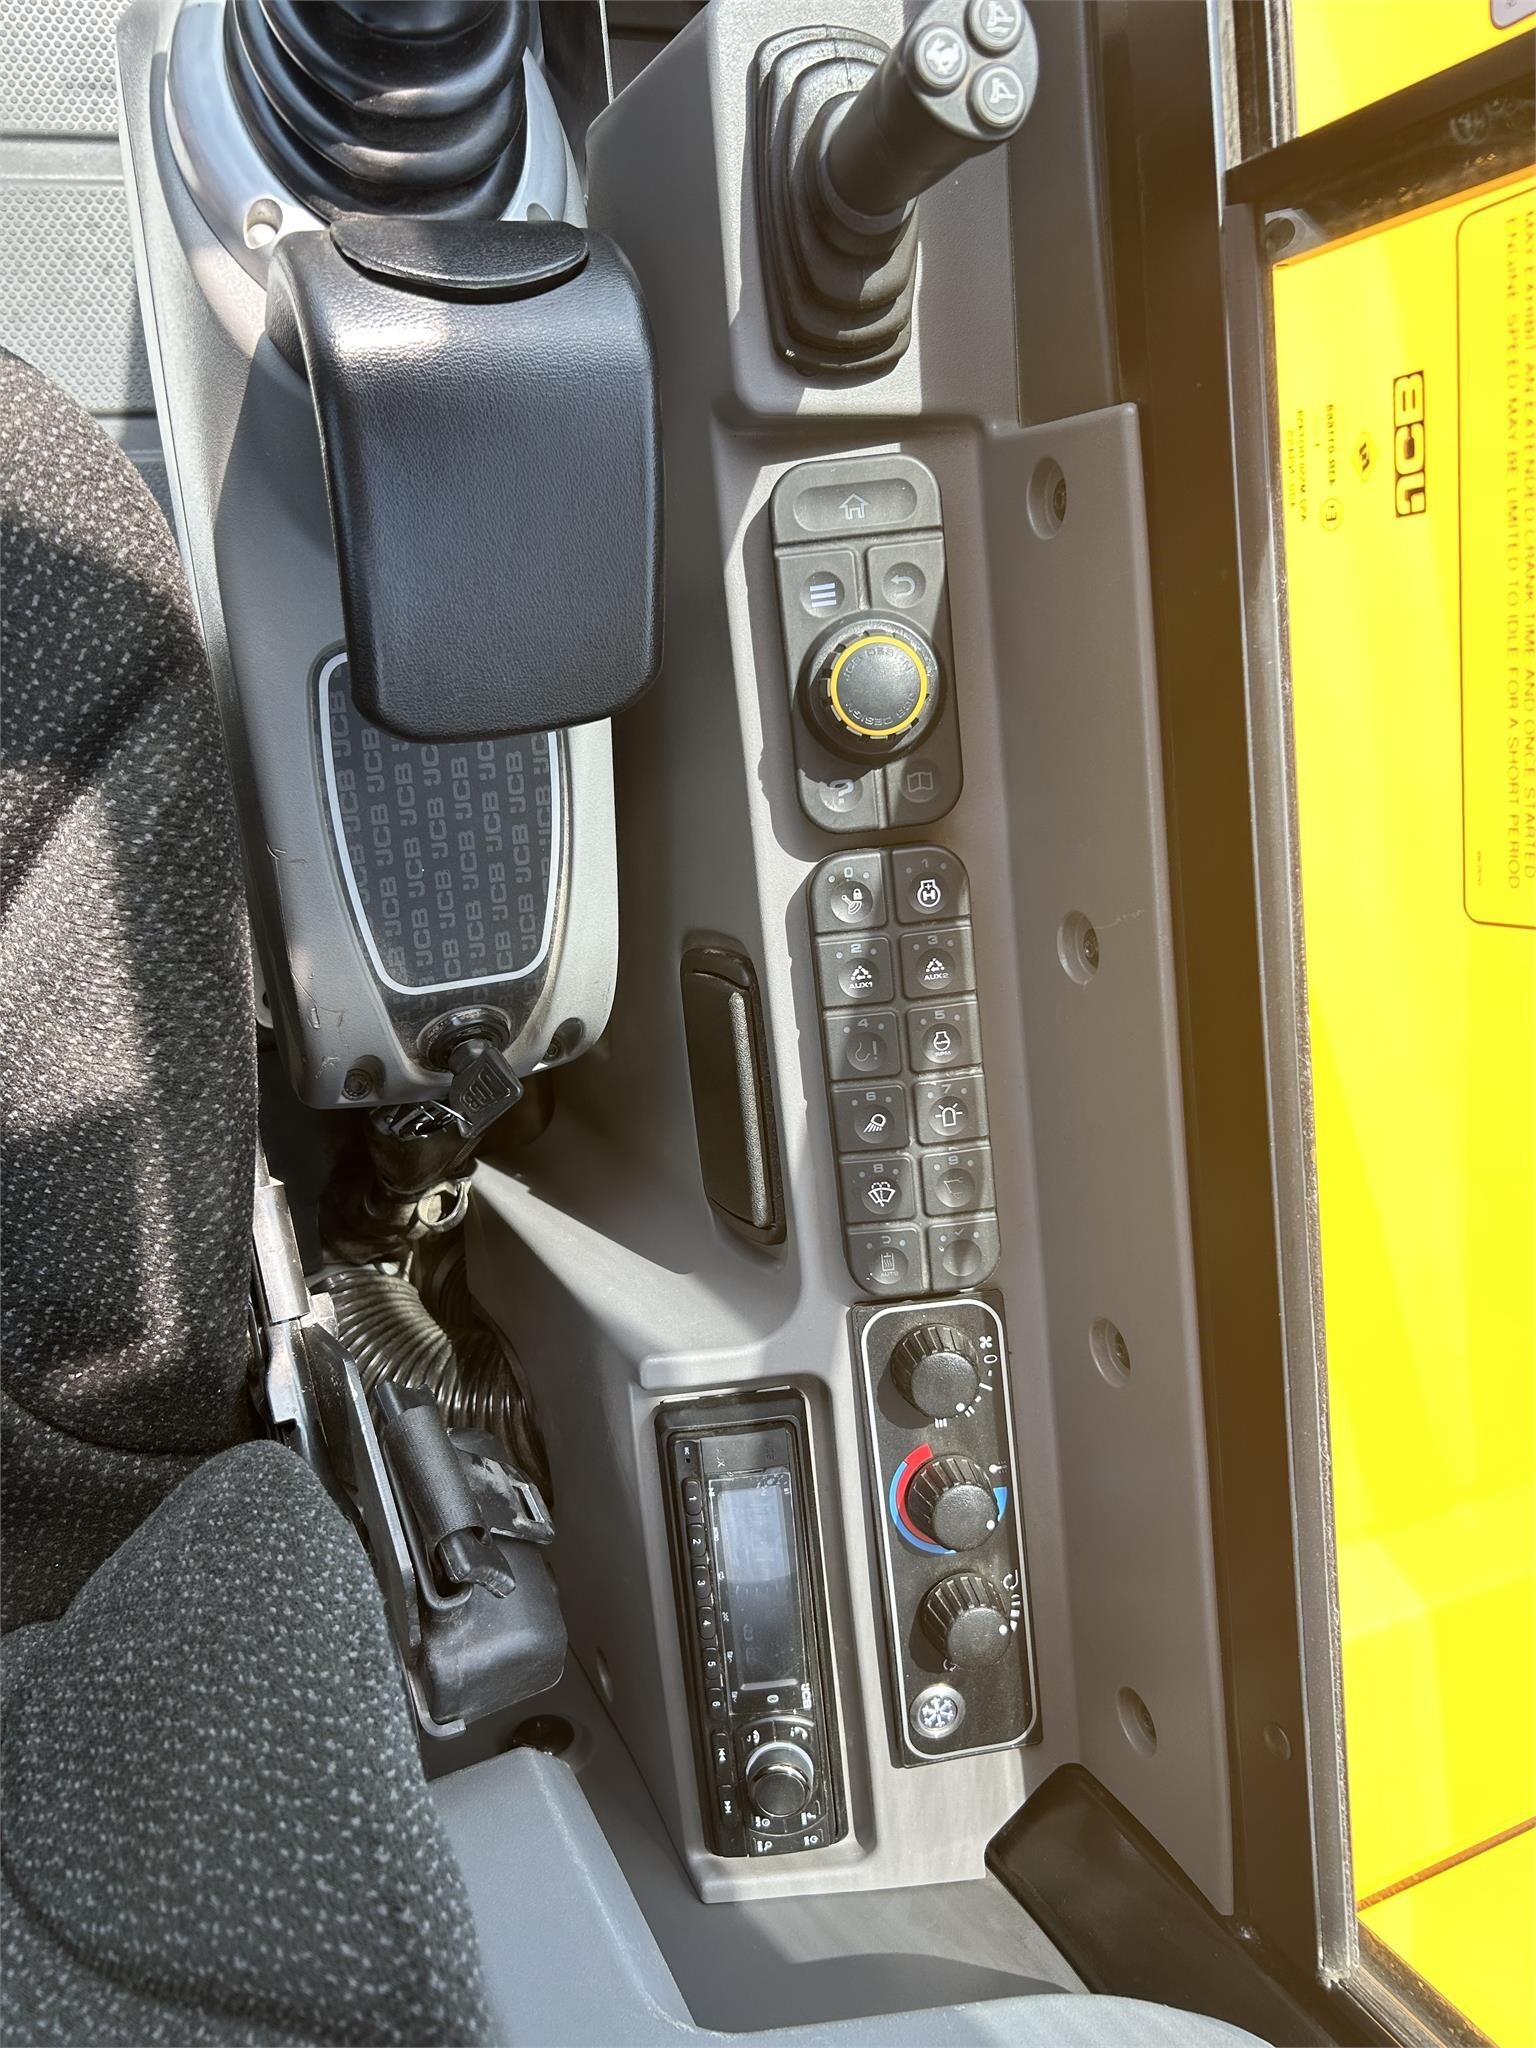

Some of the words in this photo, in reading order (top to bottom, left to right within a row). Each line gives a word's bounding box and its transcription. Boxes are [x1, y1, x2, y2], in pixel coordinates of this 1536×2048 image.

[1507, 217, 1519, 298] ENGINE
[1507, 314, 1519, 389] SPEED
[1525, 362, 1536, 392] AN
[1507, 397, 1519, 439] MAY
[1507, 451, 1519, 472] BE
[1525, 402, 1536, 521] EXTENDED
[1507, 488, 1519, 571] LIMITED
[1507, 580, 1519, 607] TO
[1525, 530, 1536, 602] CRANK
[1507, 615, 1519, 655] IDLE
[1525, 612, 1536, 657] TIME
[1508, 668, 1519, 709] FOR
[1524, 669, 1536, 711] AND
[330, 689, 351, 758] JCB
[1508, 717, 1519, 729] A
[1524, 720, 1536, 772] ONCE
[362, 728, 385, 792] JCB
[451, 756, 473, 819] JCB
[506, 751, 525, 814] JCB
[1508, 737, 1519, 804] SHORT
[336, 768, 362, 832] JCB
[396, 763, 418, 826] JCB
[482, 791, 503, 852] JCB
[368, 804, 394, 866] JCB
[428, 797, 449, 859] JCB
[512, 824, 531, 883] JCB
[1508, 815, 1519, 889] PERIOD
[1524, 787, 1536, 879] STARTED
[404, 837, 425, 898] JCB
[459, 831, 480, 890] JCB
[380, 876, 402, 936] JCB
[435, 870, 457, 929] JCB
[489, 862, 509, 921] JCB
[411, 908, 435, 967] JCB
[466, 900, 486, 958] JCB
[494, 931, 513, 970] CB
[519, 893, 537, 951] JCB
[850, 943, 862, 954] 2
[927, 935, 939, 944] 3
[442, 939, 462, 978] CB
[849, 982, 873, 990] AUX1
[924, 972, 950, 981] AUX2
[857, 1018, 870, 1028] 4
[934, 1010, 945, 1019] 5
[866, 1091, 876, 1101] 6
[942, 1084, 952, 1093] 7
[873, 1163, 884, 1173] 8
[948, 1156, 959, 1165] 9
[801, 1683, 812, 1710] JCB
